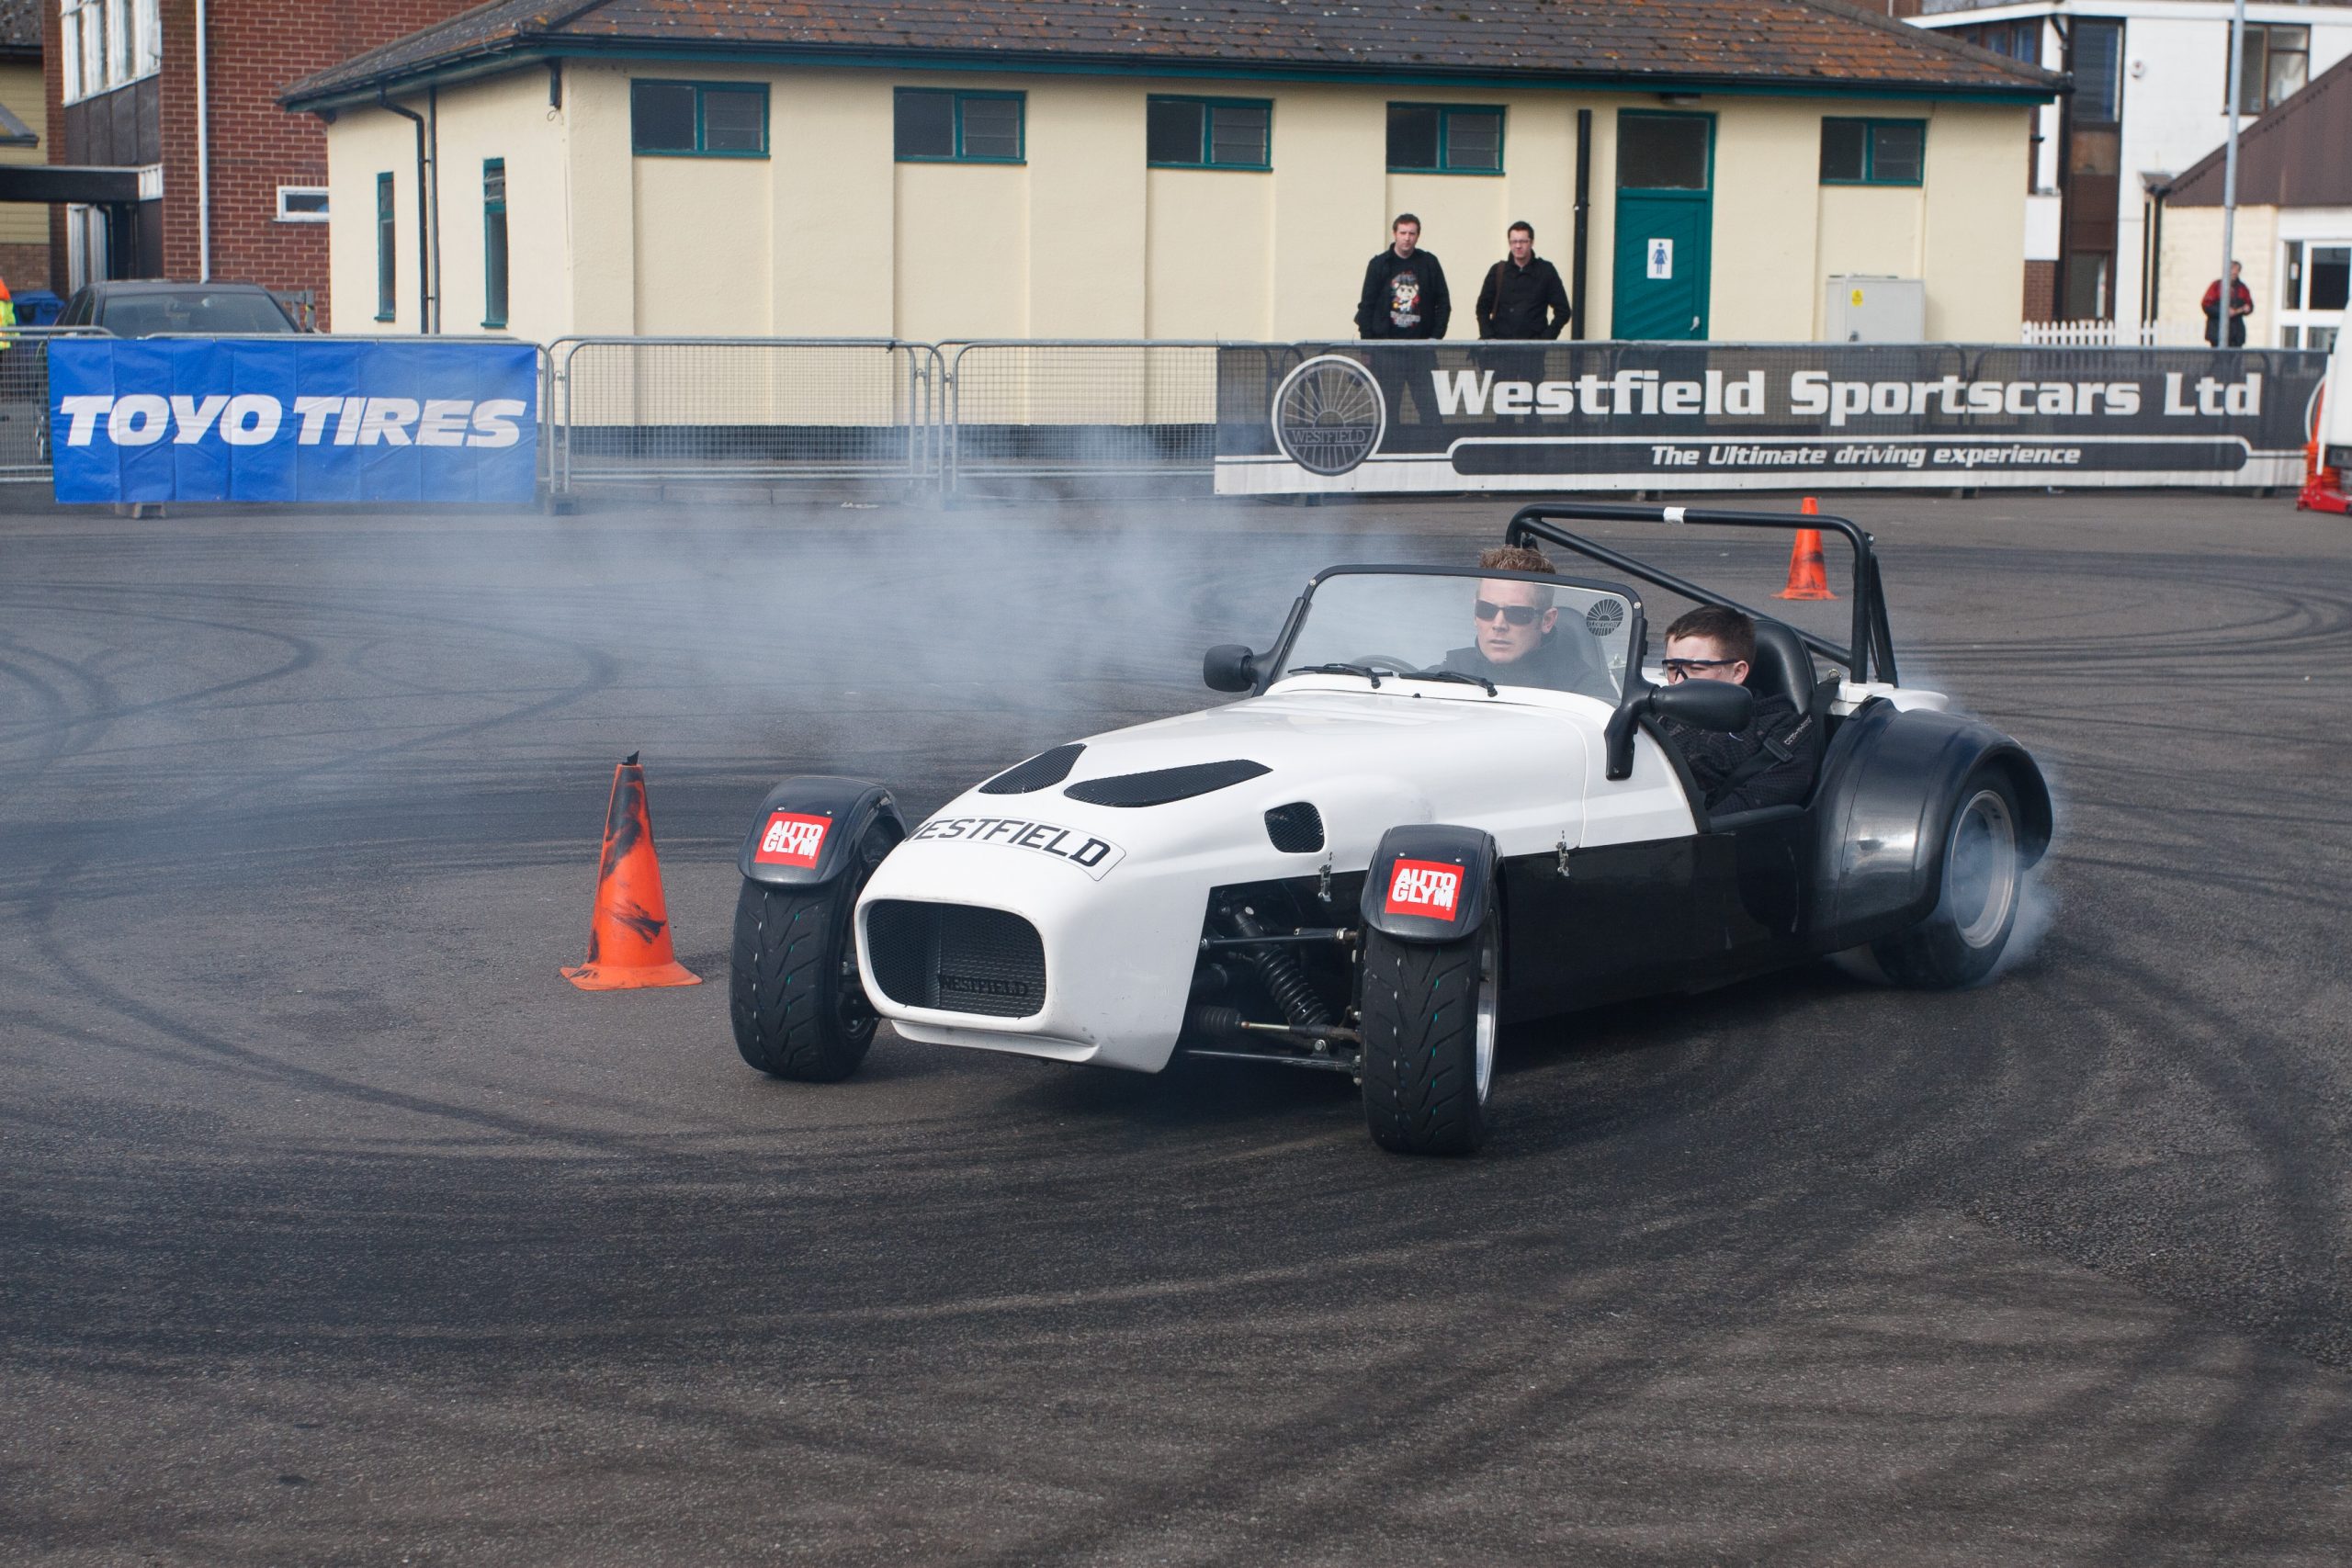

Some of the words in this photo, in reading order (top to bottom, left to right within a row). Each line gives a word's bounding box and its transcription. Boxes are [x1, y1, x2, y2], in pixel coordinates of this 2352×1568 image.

[1430, 369, 1765, 415] Westfield
[1791, 370, 2140, 426] Sportscars
[2164, 372, 2262, 416] Ltd
[61, 394, 283, 446] TOYO
[293, 396, 527, 447] TIRES
[1291, 429, 1366, 444] WESTFIELD
[1652, 446, 1700, 466] The
[1708, 446, 1826, 466] Ultimate
[1834, 445, 1926, 468] driving
[1933, 445, 2081, 468] experience
[767, 820, 824, 840] AUTO
[763, 835, 820, 857] GLYM
[1395, 868, 1457, 890] AUTO
[1392, 883, 1454, 908] GLYM
